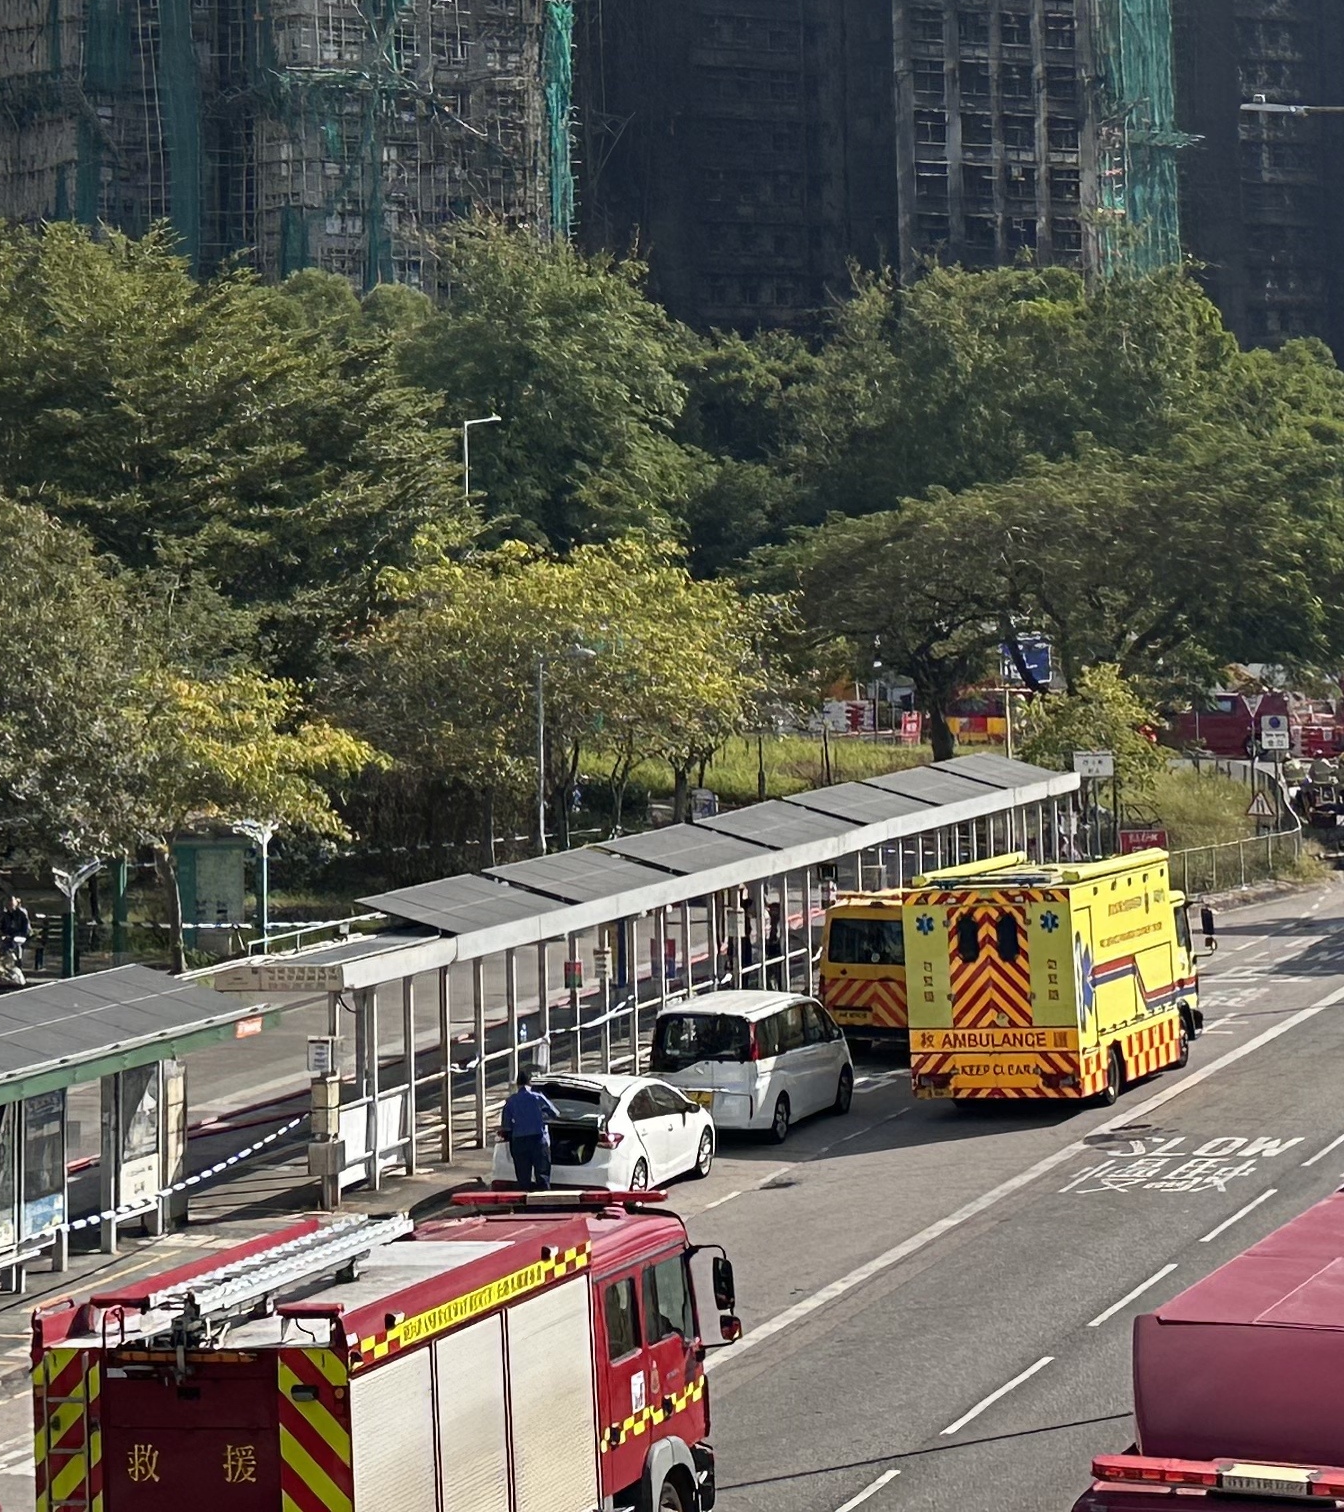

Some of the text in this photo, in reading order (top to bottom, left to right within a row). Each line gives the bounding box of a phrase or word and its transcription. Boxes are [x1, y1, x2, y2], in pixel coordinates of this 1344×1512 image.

[941, 1032, 1047, 1048] AMBULANCE
[961, 1064, 990, 1076] KEEP
[1109, 1136, 1306, 1158] SLOW
[128, 1444, 257, 1483] 救援
